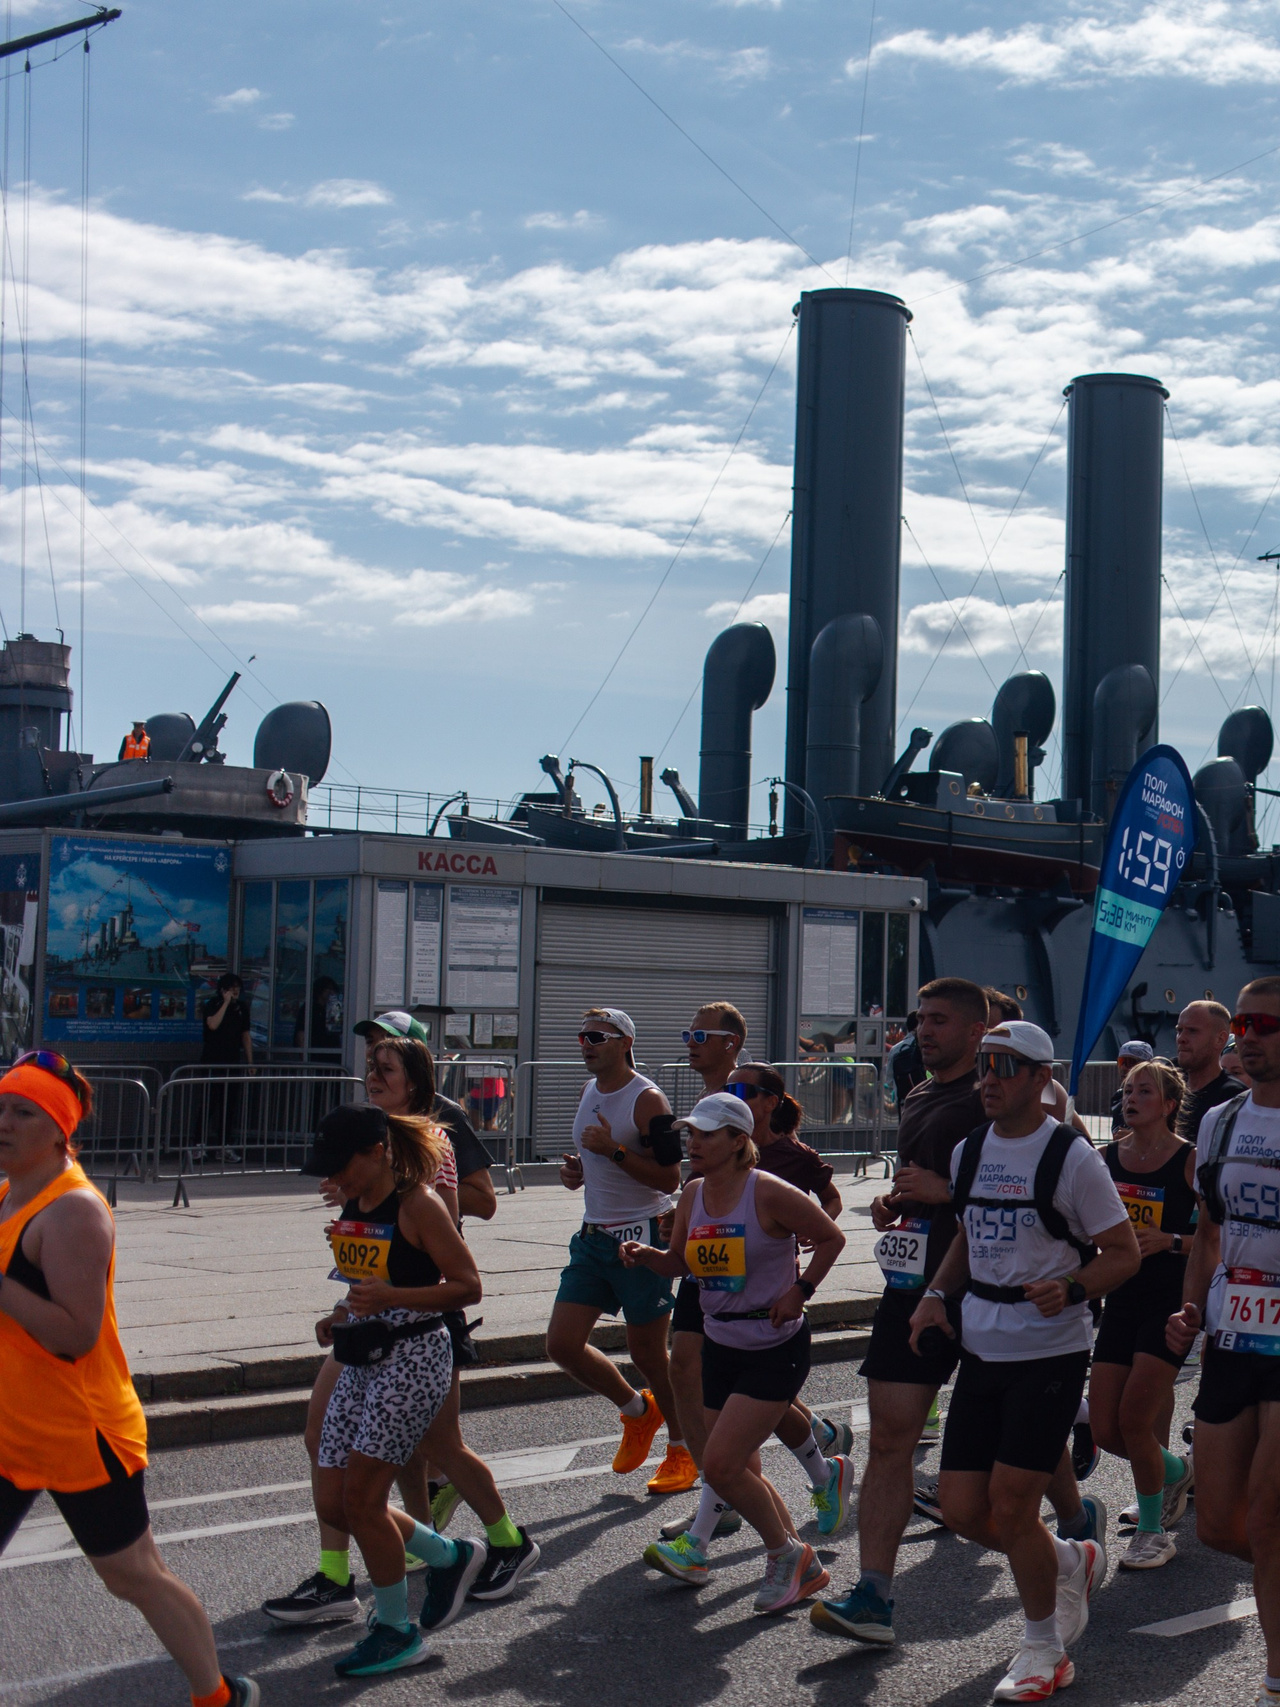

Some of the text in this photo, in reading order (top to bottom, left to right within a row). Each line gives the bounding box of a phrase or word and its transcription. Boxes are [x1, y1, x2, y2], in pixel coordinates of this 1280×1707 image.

[1143, 772, 1168, 795] ПОЛУ
[1141, 787, 1184, 820] МАРАФОН
[113, 855, 138, 863] КРЕЙСЕРЕ
[417, 850, 498, 876] КАССА
[1118, 826, 1172, 895] 1:59
[1123, 921, 1137, 934] КМ
[1237, 1134, 1267, 1145] ПОЛУ
[981, 1163, 1006, 1173] ПОЛУ
[978, 1173, 1028, 1186] МАРАФОН
[1224, 1182, 1280, 1220] 1:59
[969, 1207, 1018, 1242] 1:59
[338, 1242, 380, 1268] 6092
[697, 1243, 730, 1265] 864
[879, 1235, 919, 1261] 5352
[886, 1259, 907, 1269] СЕРГЕЙ
[1223, 1333, 1233, 1347] E
